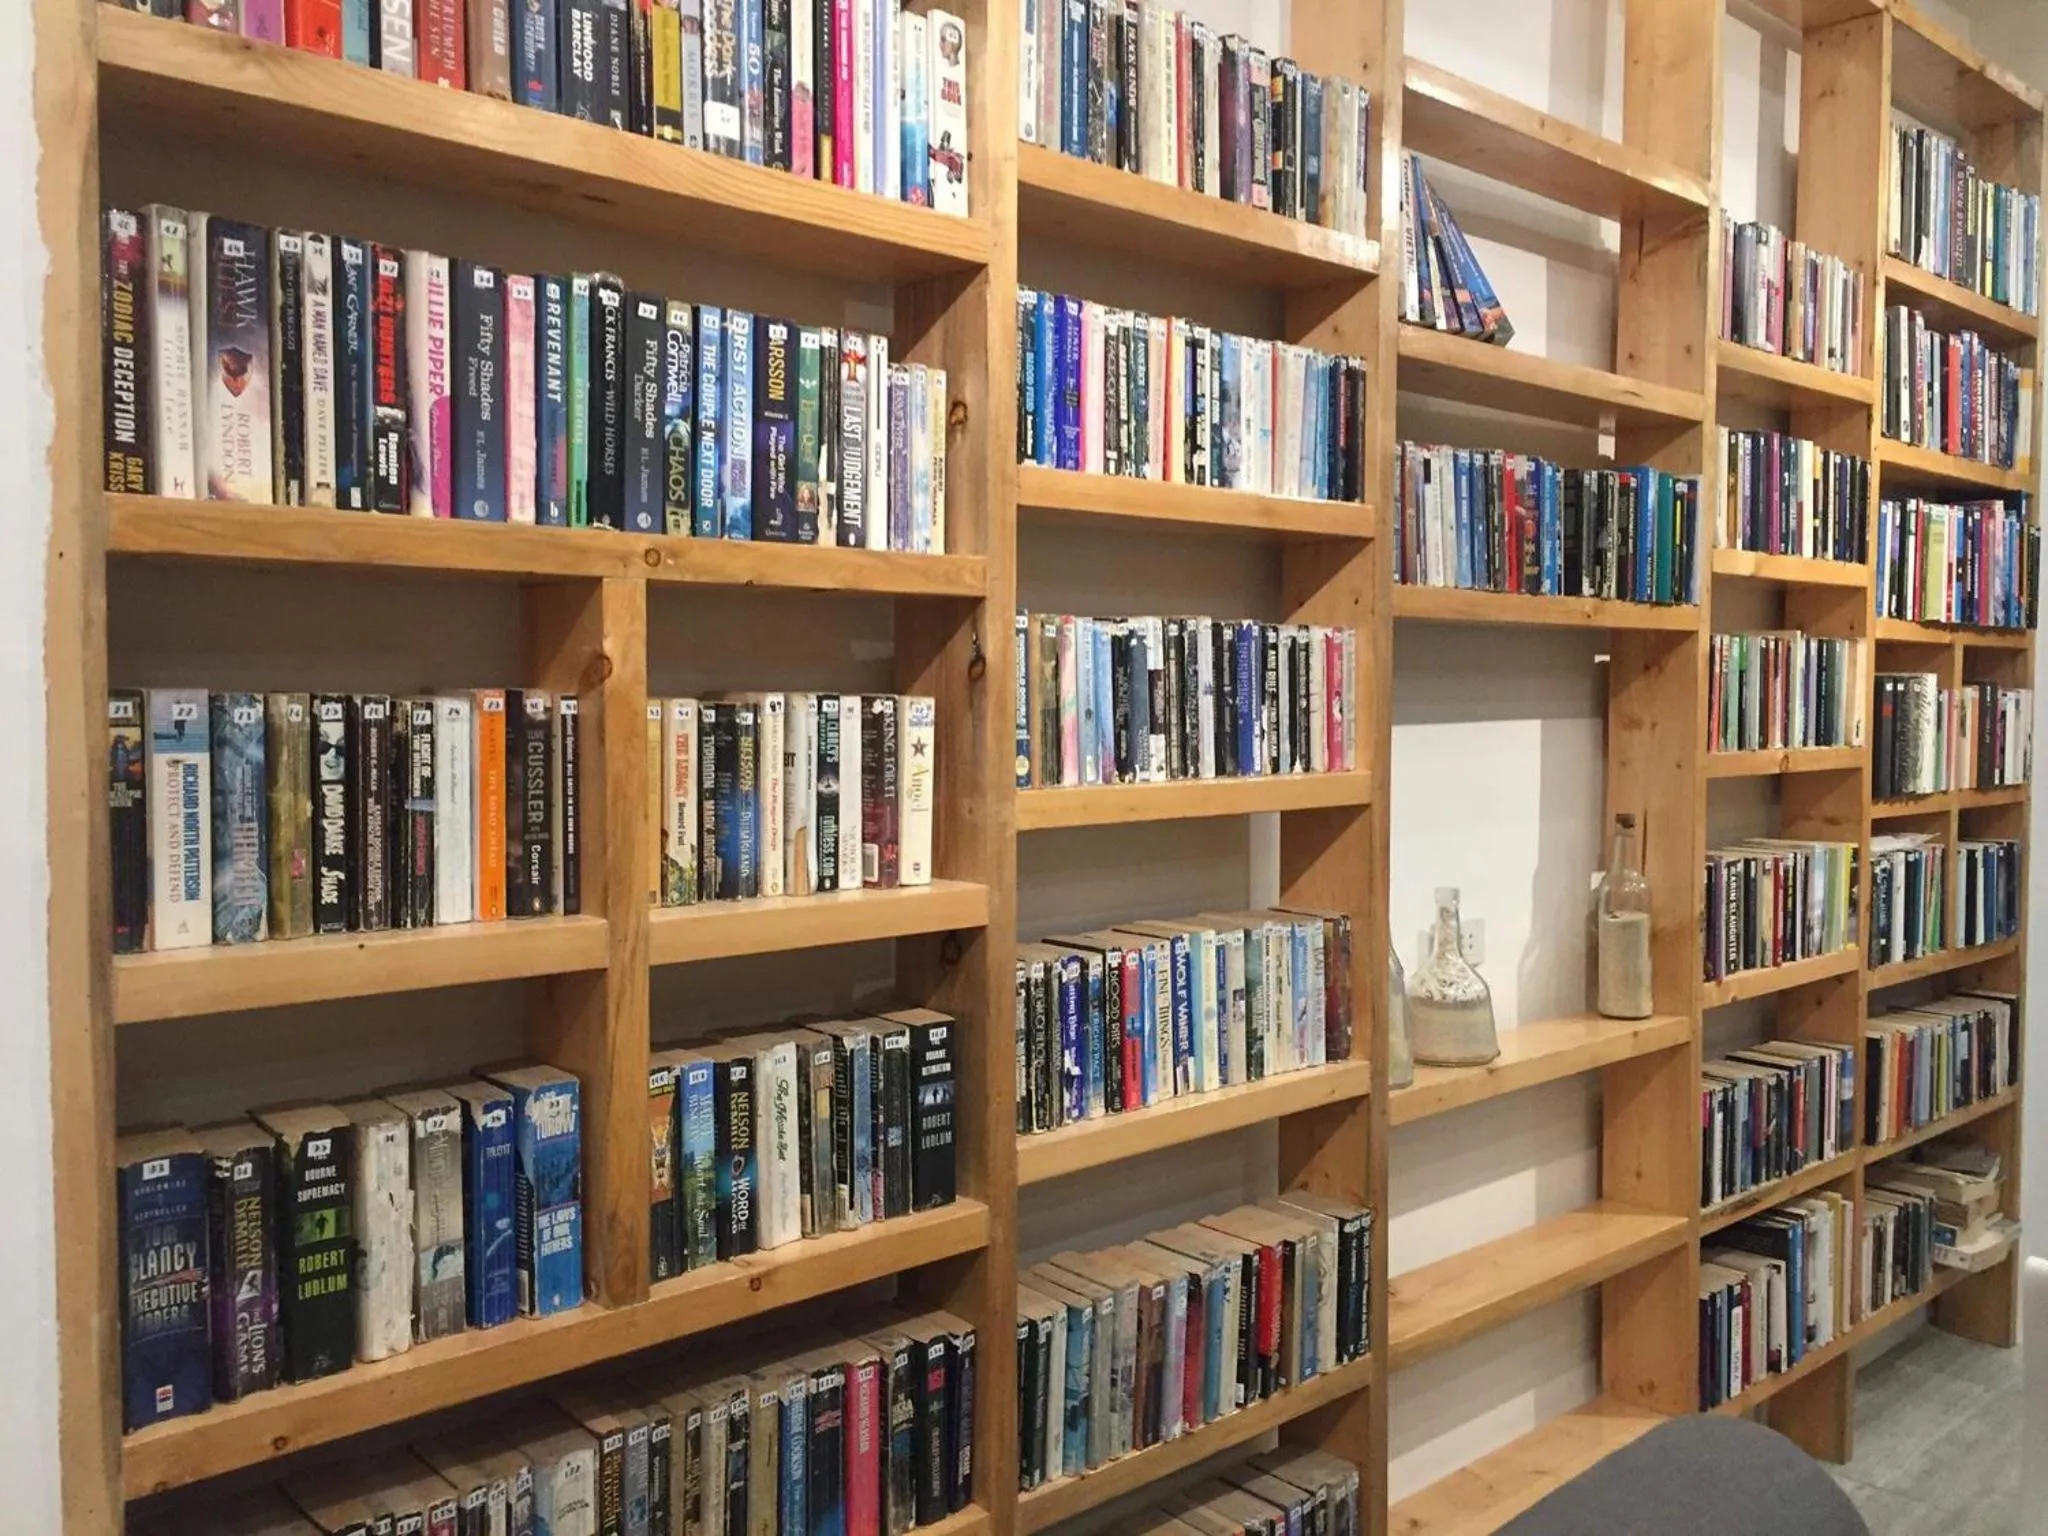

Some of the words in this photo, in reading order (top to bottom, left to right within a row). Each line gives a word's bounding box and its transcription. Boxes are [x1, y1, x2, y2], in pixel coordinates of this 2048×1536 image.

[572, 8, 582, 80] BARCLAY
[583, 12, 593, 82] LINWOOD
[610, 14, 619, 52] DIANE
[611, 57, 620, 96] NOBLE
[234, 248, 258, 328] HAWK
[312, 300, 325, 308] A
[112, 280, 134, 343] ZODIAC
[312, 310, 326, 330] MAN
[479, 314, 493, 354] Fifty
[547, 304, 561, 403] REVENANT
[429, 335, 443, 396] PIPER
[605, 327, 616, 381] FRANCIS
[644, 340, 657, 377] Fifty
[667, 330, 682, 402] Cornwell
[679, 343, 690, 393] Patricia
[703, 344, 715, 370] THE
[768, 338, 784, 400] ARSSON
[114, 346, 136, 442] DECEPTION
[314, 368, 328, 392] DAVE
[468, 357, 478, 396] Freed
[480, 360, 493, 420] Shades
[317, 398, 327, 429] DAVE
[605, 389, 615, 423] WILD
[634, 374, 644, 422] Darker
[645, 382, 656, 438] Shades
[702, 374, 716, 426] COUPLE
[733, 383, 749, 455] ACTION
[843, 406, 861, 442] LAST
[221, 404, 236, 482] LYNDON
[238, 412, 252, 476] ROBERT
[318, 434, 328, 477] PELZER
[377, 438, 388, 477] Lewis
[388, 432, 398, 485] Damien
[604, 427, 615, 475] HORSES
[701, 432, 715, 466] NEXT
[769, 426, 778, 459] Played
[778, 435, 786, 450] The
[108, 452, 125, 491] KRISS
[126, 458, 144, 490] GARY
[476, 450, 487, 489] James
[668, 433, 684, 500] CHAOS
[843, 445, 861, 527] JUDGEMENT
[701, 468, 715, 508] DOOR
[769, 480, 777, 499] Fire
[413, 734, 421, 752] THE
[420, 734, 431, 764] FLIGHT
[676, 733, 688, 756] THE
[703, 736, 714, 789] TYPHOON
[167, 764, 181, 818] PROTECT
[183, 764, 199, 811] RICHARD
[413, 753, 421, 797] INTRUDER
[421, 765, 431, 779] OF
[527, 742, 544, 824] CUSSLER
[676, 758, 688, 799] LEGACY
[907, 764, 929, 812] Angel
[324, 785, 342, 817] DAVID
[489, 796, 498, 827] ROAD
[678, 802, 686, 830] Howard
[704, 800, 714, 829] MARK
[168, 823, 179, 850] AND
[184, 812, 200, 846] NORTH
[323, 819, 343, 855] DARKE
[678, 831, 686, 846] Fast
[169, 854, 180, 903] DEFEND
[184, 848, 200, 901] PATTERSON
[530, 845, 541, 885] Corsair
[322, 867, 345, 904] SHADE
[1729, 902, 1738, 961] SLAUGHTER
[1175, 955, 1187, 1000] WOLF
[1158, 1003, 1170, 1049] THINGS
[926, 1049, 946, 1061] BOURNE
[737, 1091, 749, 1149] NELSON
[922, 1113, 950, 1130] ROBERT
[921, 1132, 952, 1149] LUDLUM
[297, 1183, 345, 1203] SUPREMACY
[304, 1165, 337, 1182] BOURNE
[553, 1206, 576, 1226] LAWS
[737, 1177, 750, 1220] WORD
[144, 1224, 178, 1247] TOM
[249, 1197, 264, 1268] NELSON
[130, 1243, 197, 1283] CLANCY
[299, 1249, 346, 1275] ROBERT
[132, 1282, 198, 1313] EXECUTIVE
[298, 1274, 348, 1300] LUDLUM
